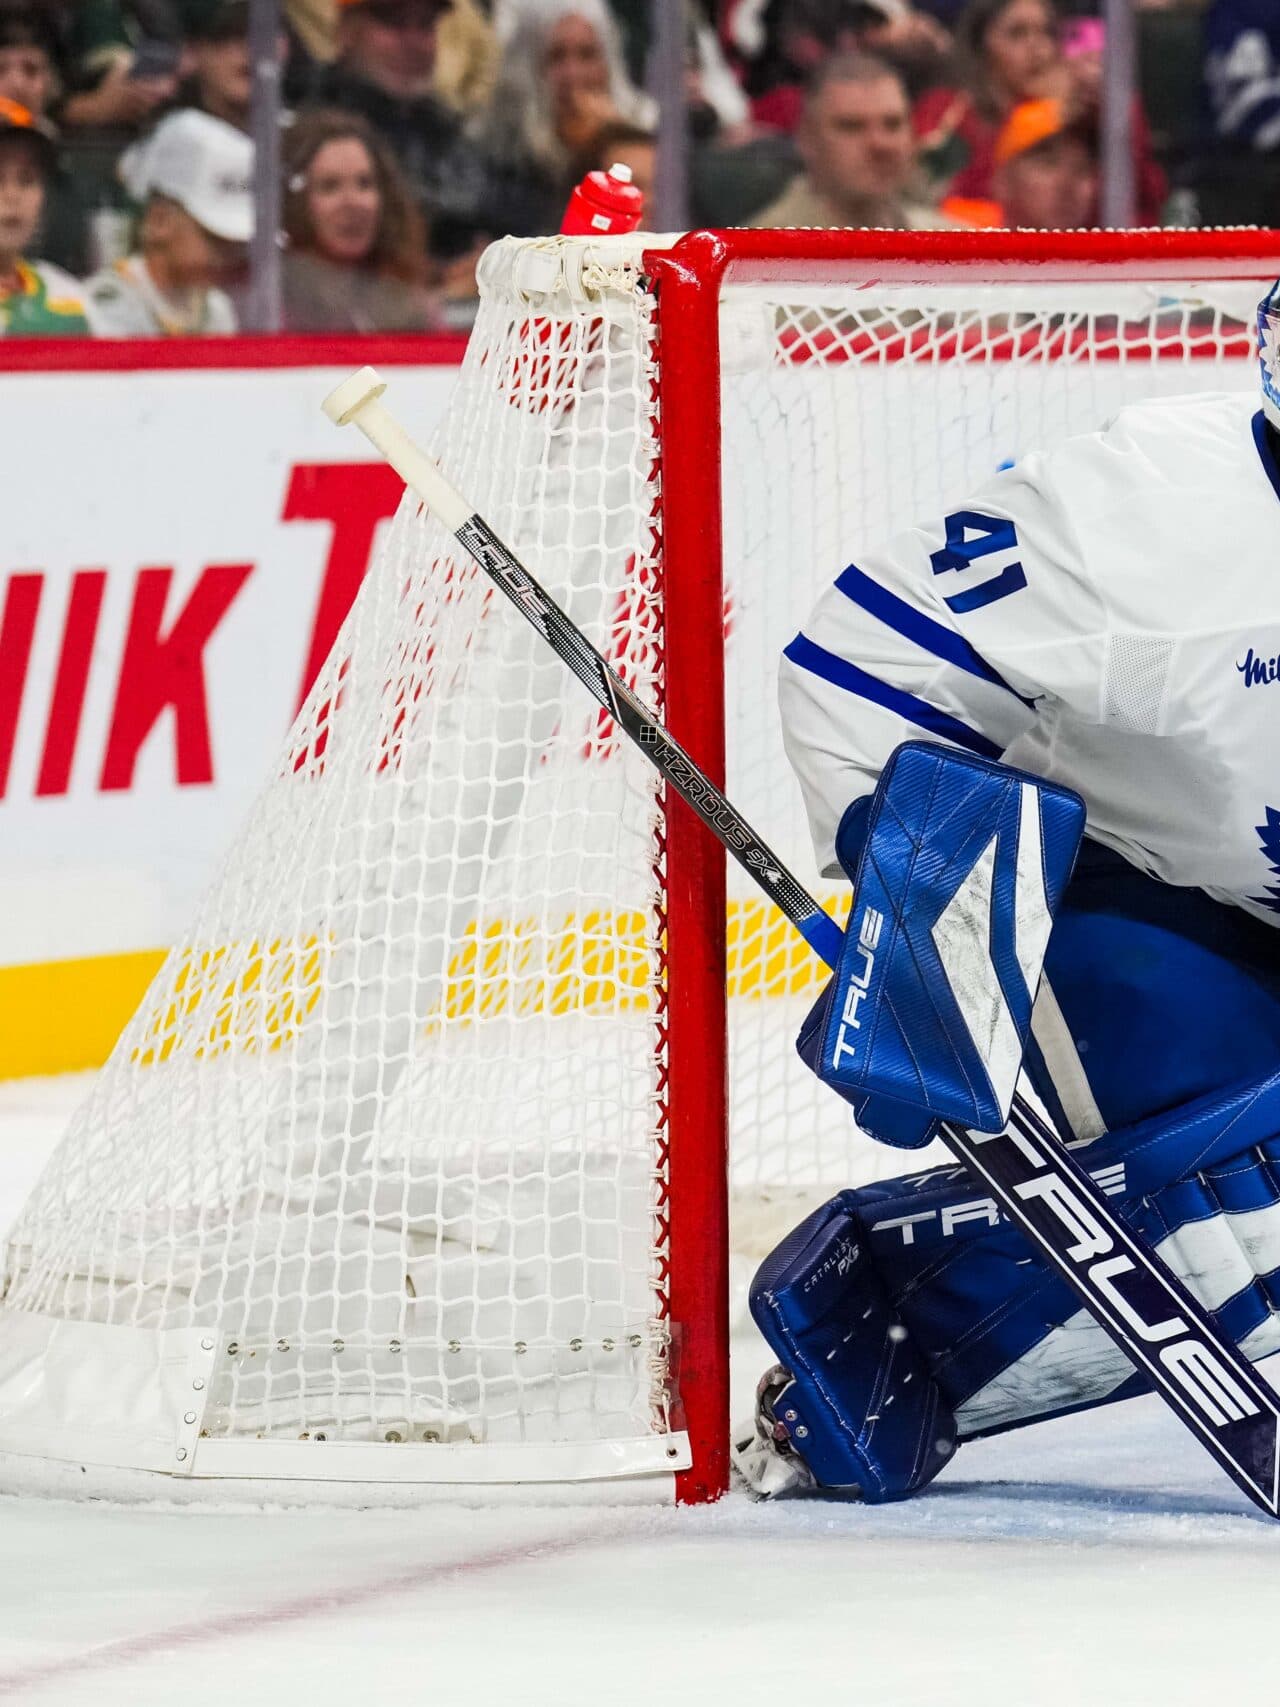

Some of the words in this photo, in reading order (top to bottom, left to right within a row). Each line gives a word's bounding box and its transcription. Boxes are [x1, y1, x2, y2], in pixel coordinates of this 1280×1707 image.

[465, 519, 550, 615] TRUE
[929, 510, 1028, 614] 41
[654, 742, 752, 850] HZRDUS
[832, 905, 883, 1071] TRUE
[966, 1119, 1262, 1427] TRUE
